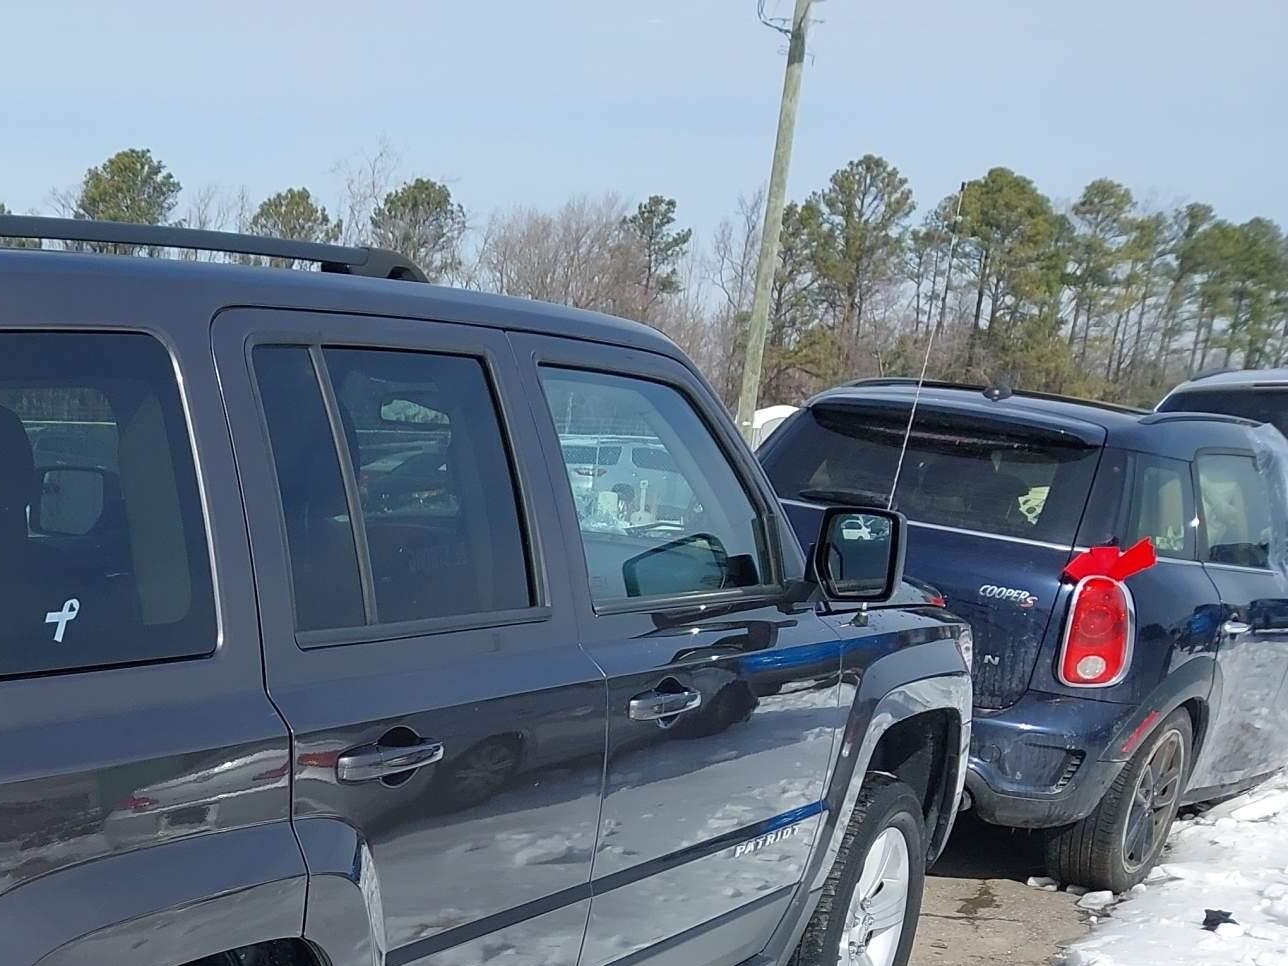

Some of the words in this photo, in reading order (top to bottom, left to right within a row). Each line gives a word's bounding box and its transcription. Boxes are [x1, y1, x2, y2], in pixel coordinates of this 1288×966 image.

[979, 585, 1029, 602] COOPER
[1020, 596, 1038, 608] S
[735, 825, 800, 857] PATRIOT
